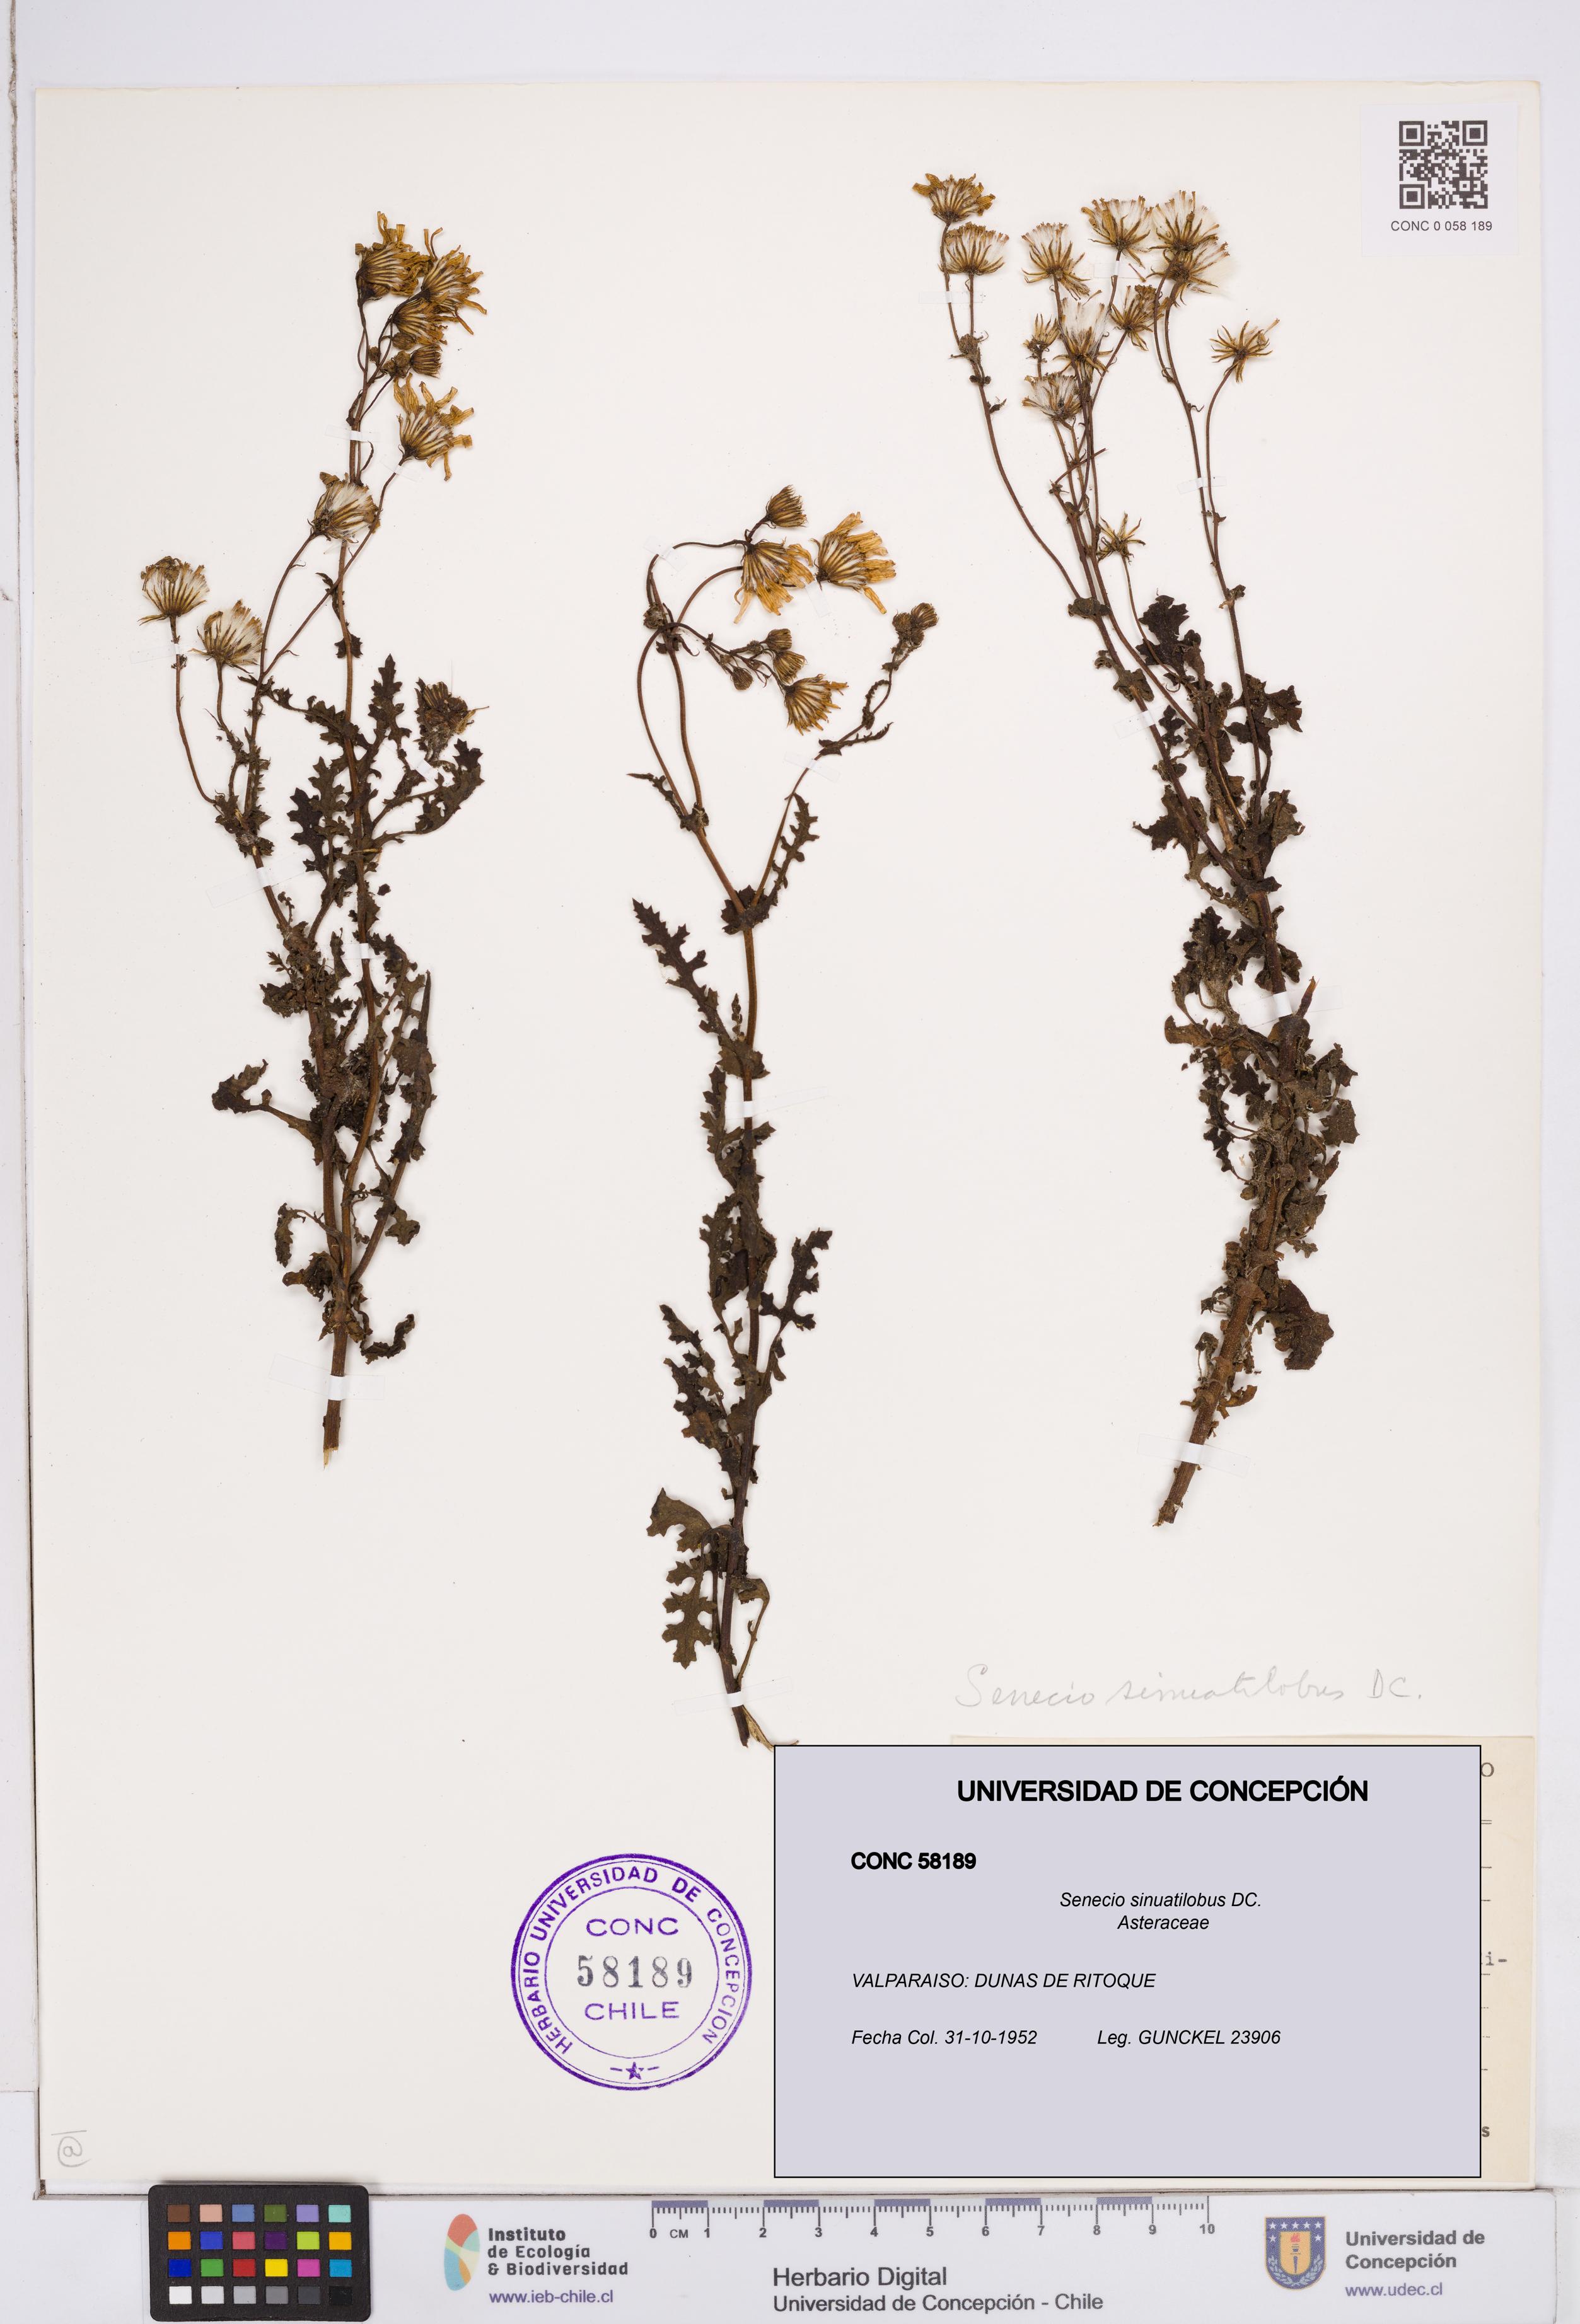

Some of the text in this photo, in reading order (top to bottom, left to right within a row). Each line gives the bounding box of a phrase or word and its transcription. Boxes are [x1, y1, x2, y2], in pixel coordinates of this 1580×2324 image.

[1391, 220, 1492, 231] CONC 0 058 189
[955, 1663, 1095, 1708] Senecio
[1367, 1668, 1423, 1700] DC.
[586, 1917, 679, 1937] CONC
[523, 1866, 740, 2055] HERBARIO UNIVERSIDAD DE CONCEPCION
[577, 1955, 692, 1989] 58189
[584, 2001, 680, 2021] CHILE
[488, 2226, 566, 2241] Instituto
[649, 2224, 1215, 2239] 0 CM 1 2 3 4 5 6 7 8 9 10
[1345, 2229, 1485, 2246] Universidad de
[487, 2244, 590, 2261] de Ecología
[488, 2261, 628, 2276] & Biodiversidad
[1345, 2252, 1456, 2272] Concepción
[773, 2266, 947, 2290] Herbario Digital
[489, 2289, 613, 2303] www.ieb-chile.cl
[1345, 2282, 1443, 2298] www.udec.cl
[774, 2294, 886, 2312] Universidad
[892, 2294, 916, 2311] de
[922, 2294, 1035, 2315] Concepción
[1055, 2293, 1103, 2310] Chile
